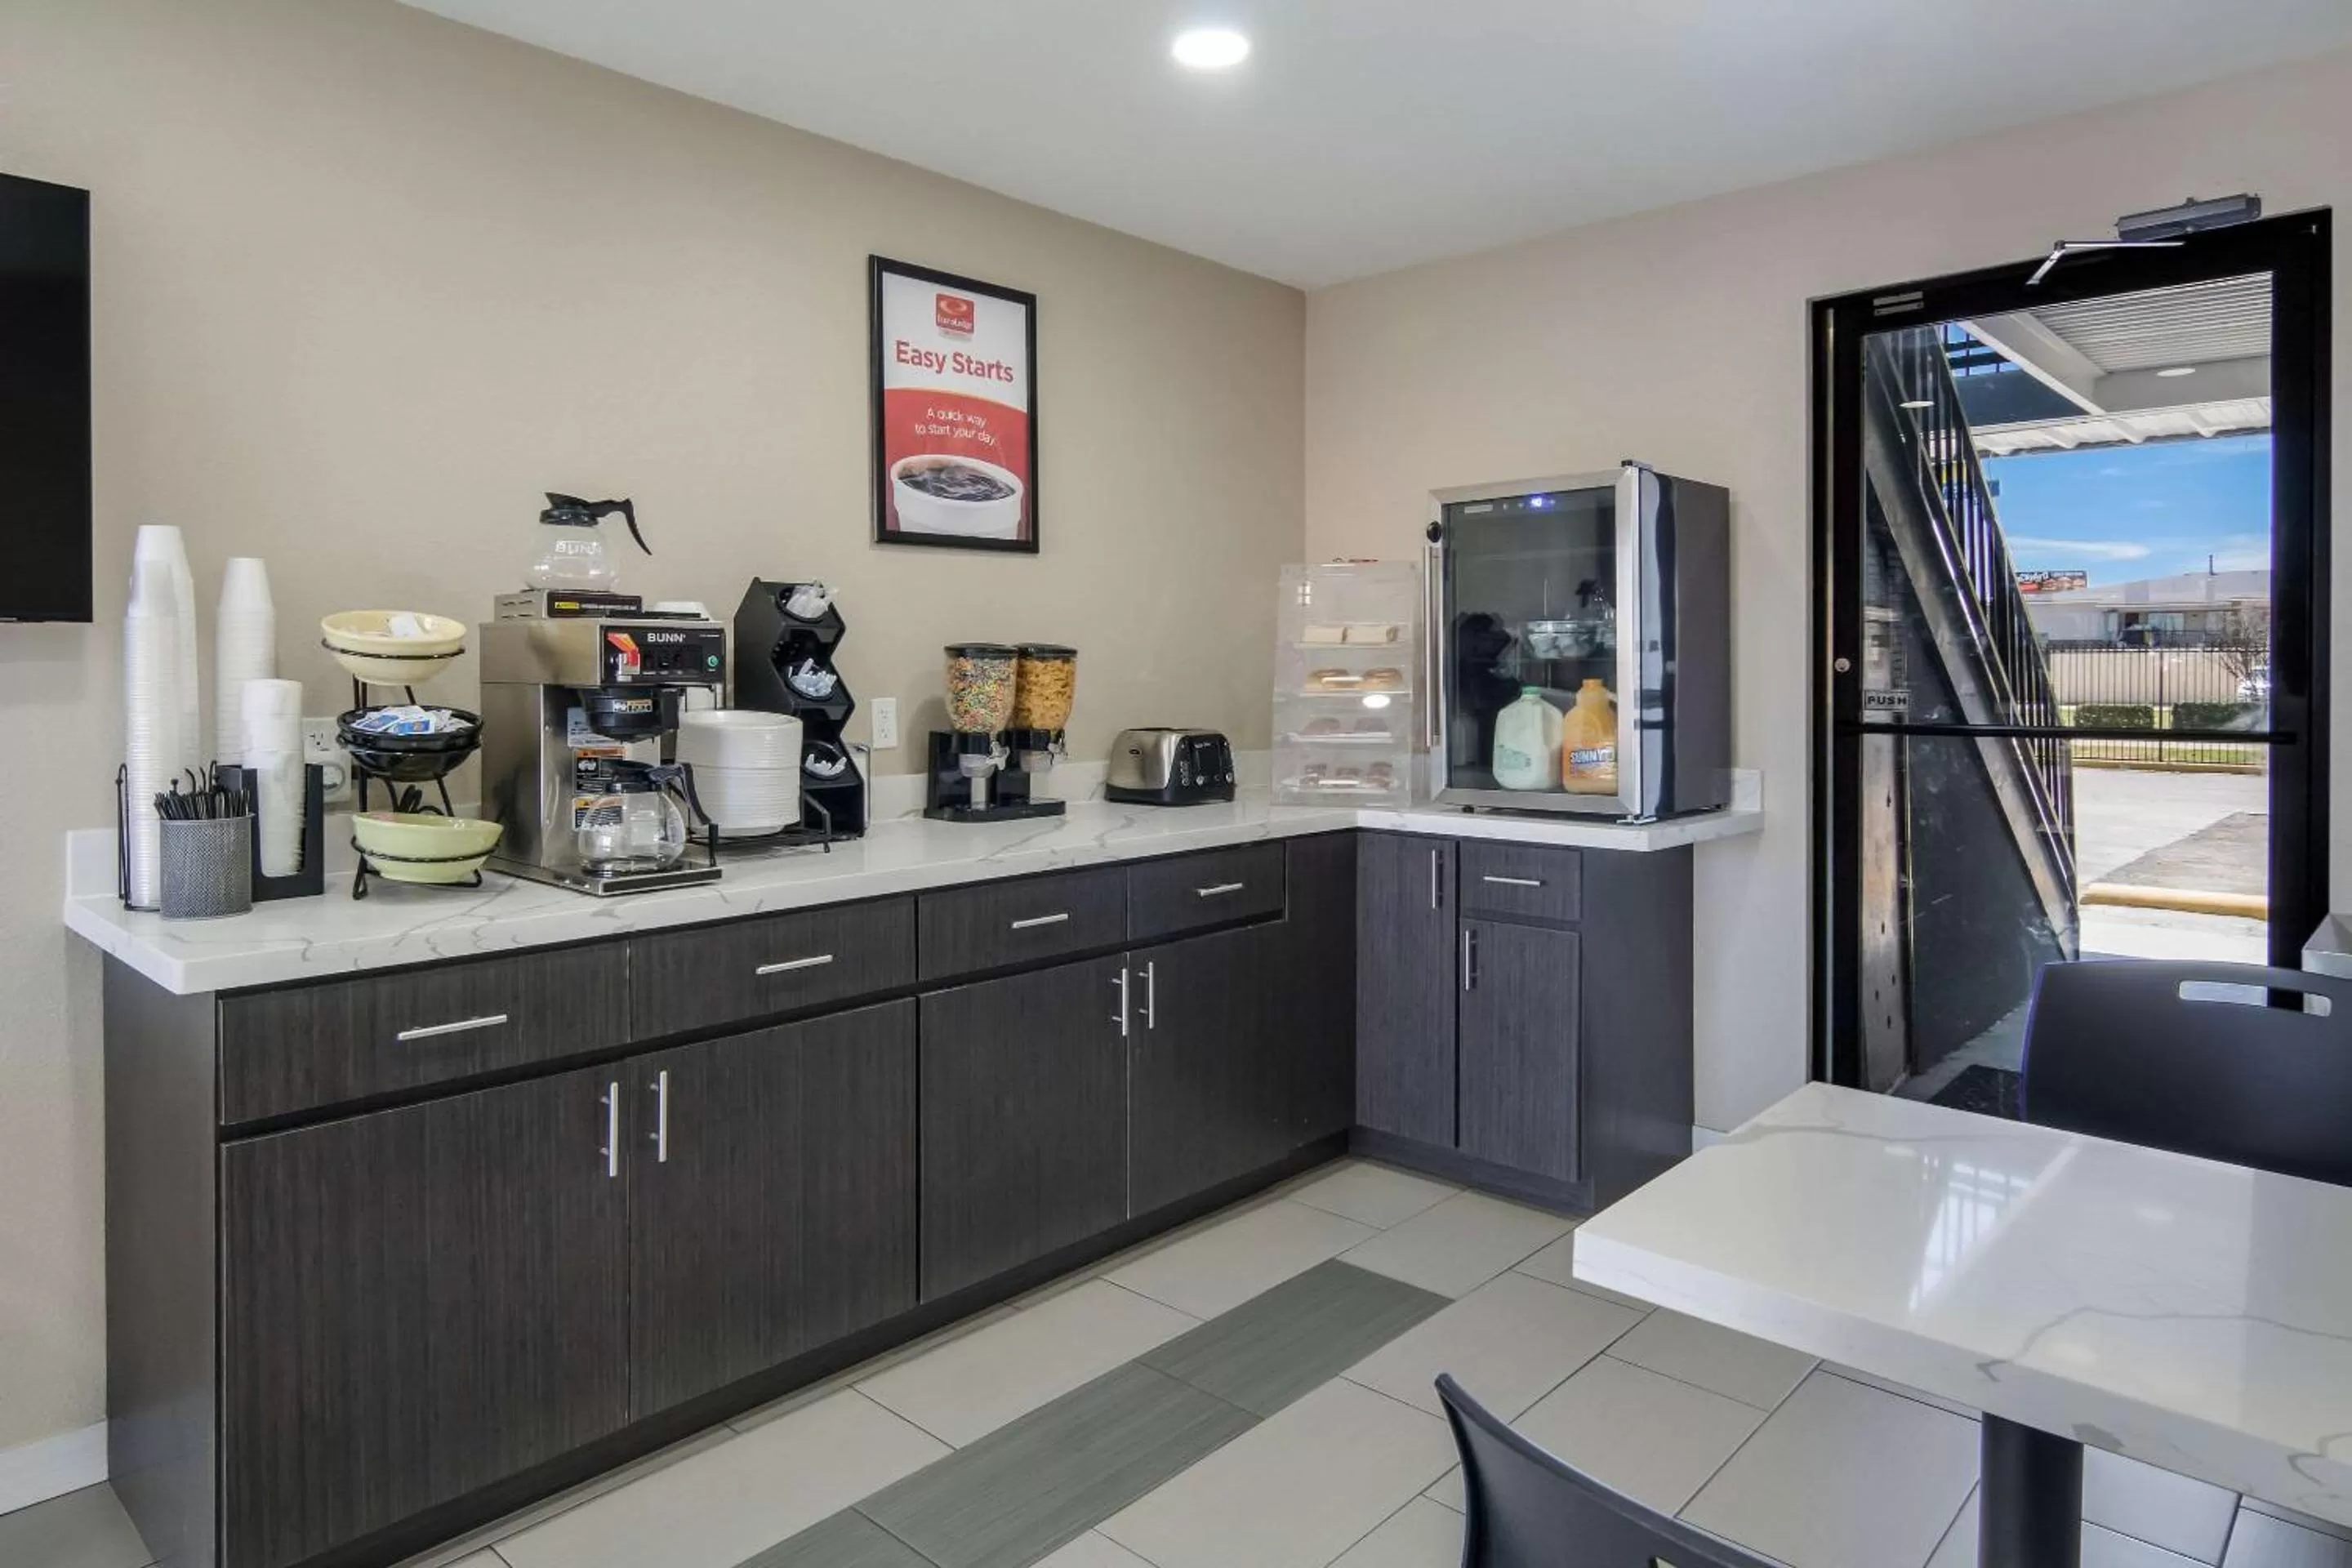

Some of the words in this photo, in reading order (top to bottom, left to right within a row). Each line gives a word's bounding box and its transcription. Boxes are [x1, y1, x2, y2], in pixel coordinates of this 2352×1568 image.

[896, 340, 947, 374] Easy
[952, 351, 1013, 383] Starts
[927, 408, 935, 419] A
[937, 409, 964, 423] quick
[966, 414, 987, 429] way
[915, 423, 926, 435] to
[928, 423, 951, 436] start
[953, 425, 976, 439] your
[647, 633, 684, 643] BUNN
[1868, 695, 1907, 705] PUSH
